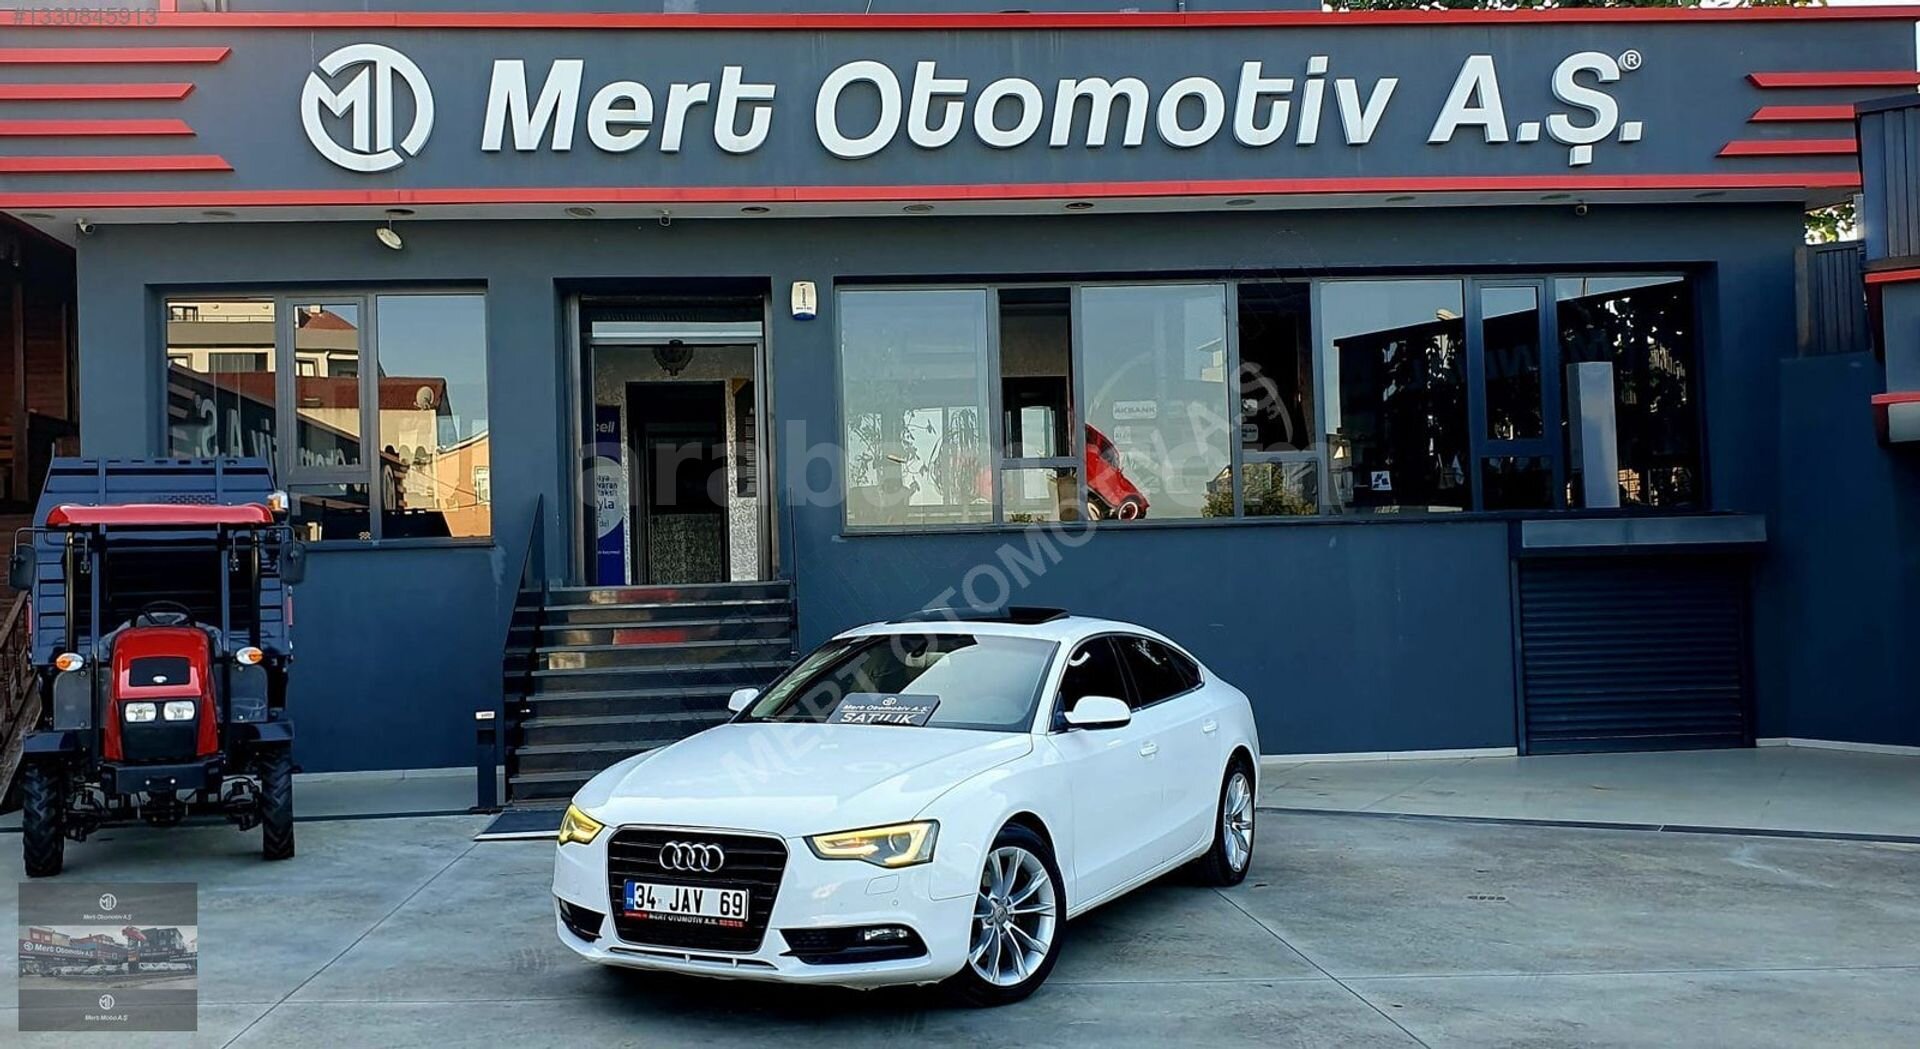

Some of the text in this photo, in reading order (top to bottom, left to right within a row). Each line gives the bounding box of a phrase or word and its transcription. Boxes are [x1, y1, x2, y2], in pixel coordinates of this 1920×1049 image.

[480, 58, 776, 154] Mert
[814, 55, 1398, 160] Otomotiv
[635, 885, 743, 916] 34 JAV 69
